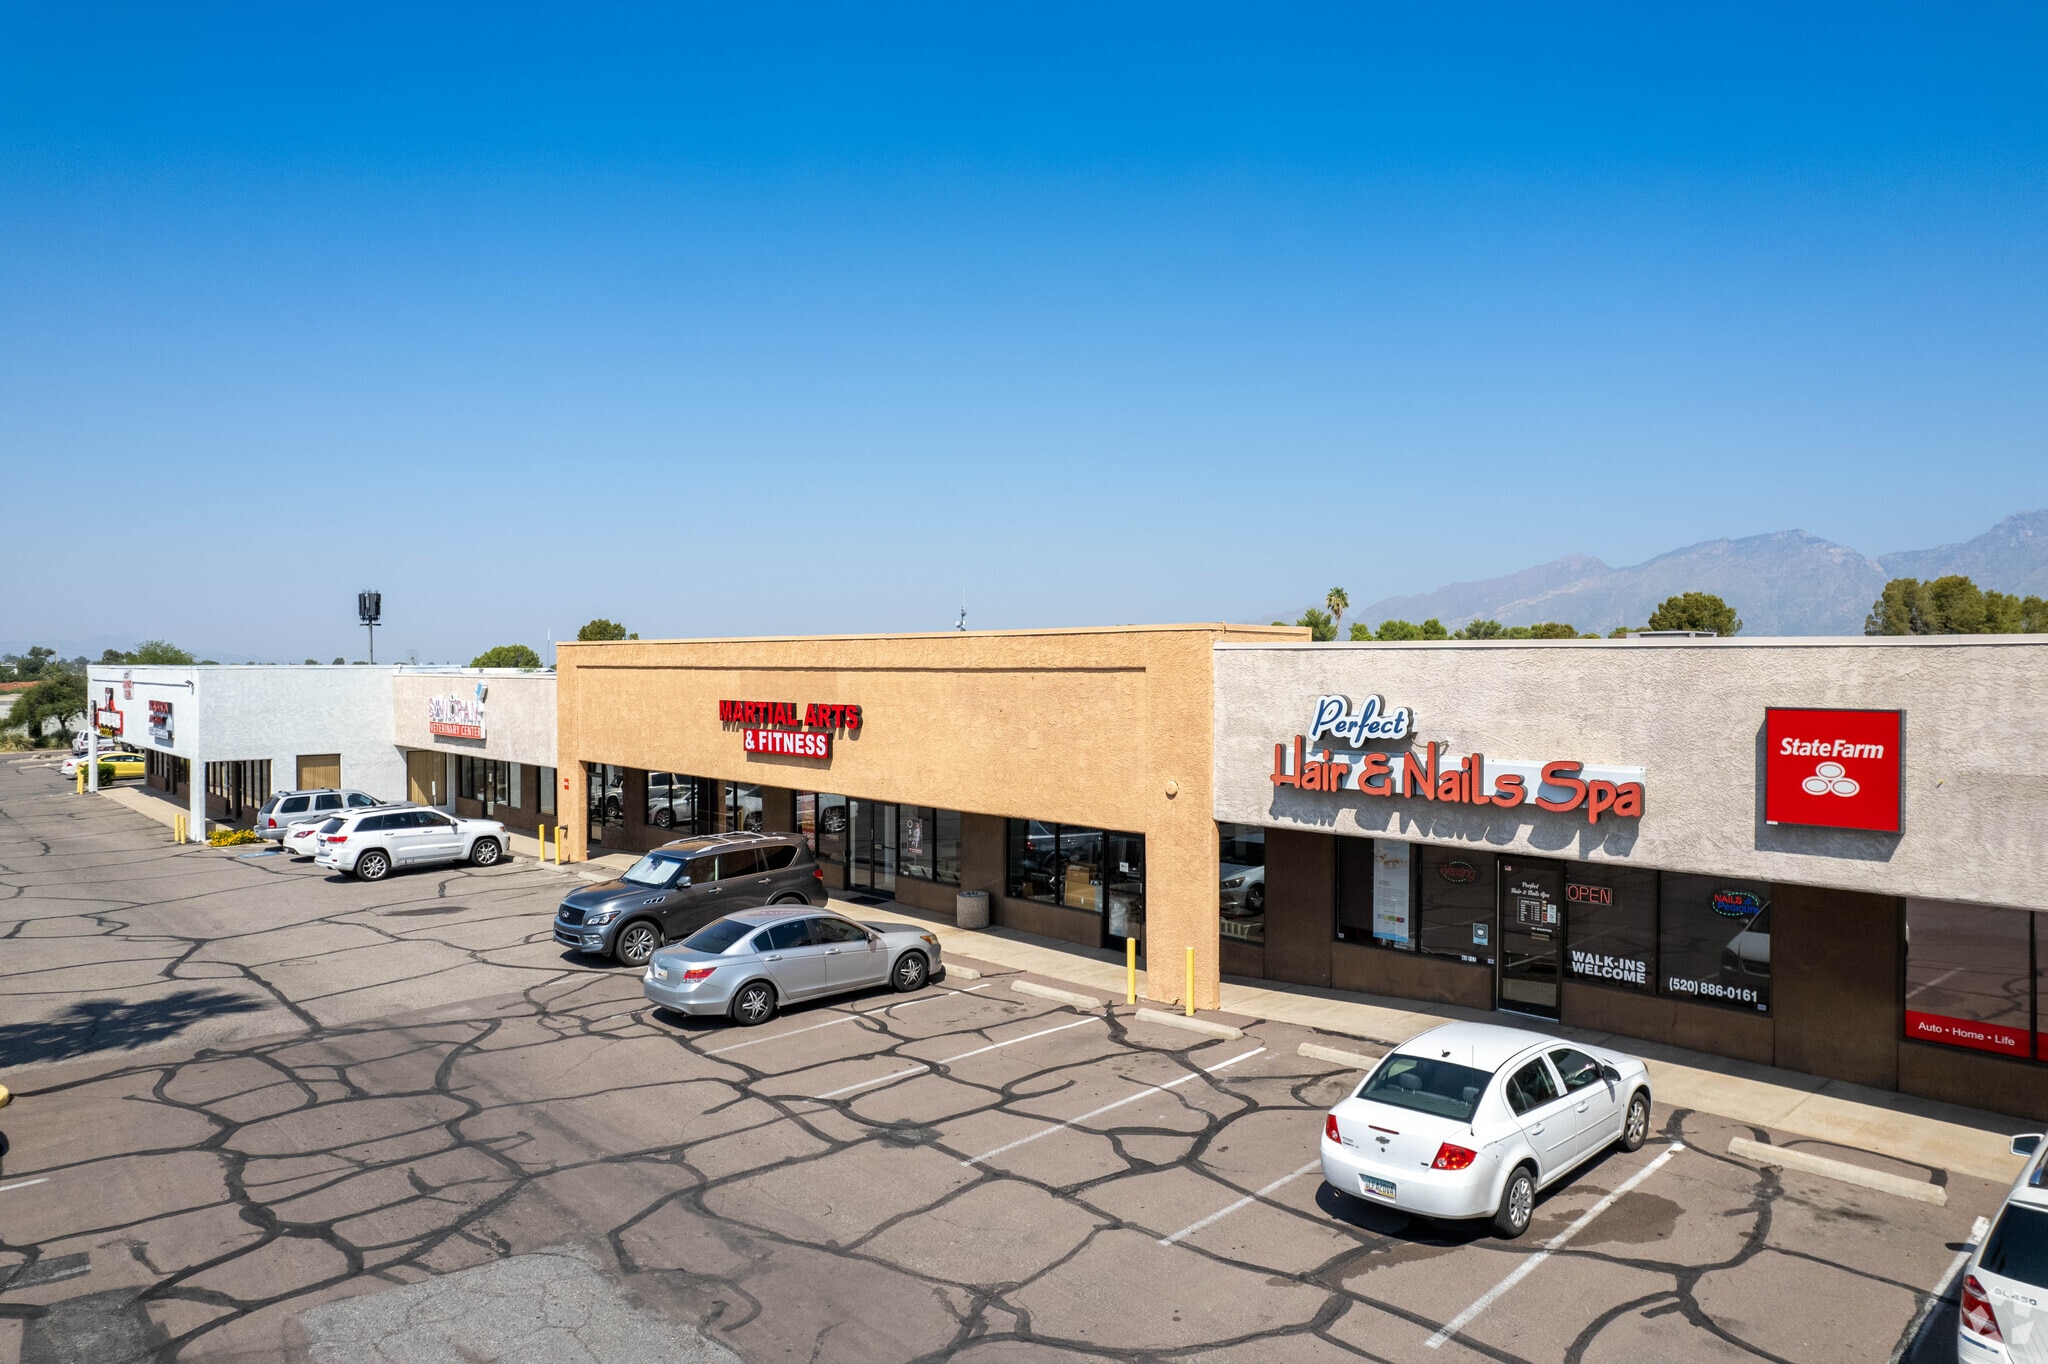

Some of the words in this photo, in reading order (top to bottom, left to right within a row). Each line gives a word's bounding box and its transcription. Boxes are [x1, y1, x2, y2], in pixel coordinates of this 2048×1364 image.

[719, 700, 798, 726] MARTIAL
[804, 703, 858, 729] ARTS
[1310, 697, 1408, 746] Perfect
[429, 723, 460, 735] VETERINARY
[461, 726, 481, 737] CENTER
[745, 730, 755, 749] &
[758, 731, 826, 756] FITNESS
[1270, 735, 1349, 793] Hair
[1357, 752, 1393, 797] &
[1535, 760, 1643, 824] Spa
[1440, 864, 1477, 881] Waxing
[1567, 885, 1611, 905] OPEN
[1714, 894, 1742, 905] NAILS
[1572, 950, 1646, 972] WALK-INS
[1572, 961, 1646, 984] WELCOME
[1669, 977, 1699, 995] (520)
[1700, 983, 1757, 1003] 886-0161
[1918, 1022, 1942, 1034] Auto
[1952, 1027, 1984, 1041] Home
[1994, 1035, 2015, 1046] Life
